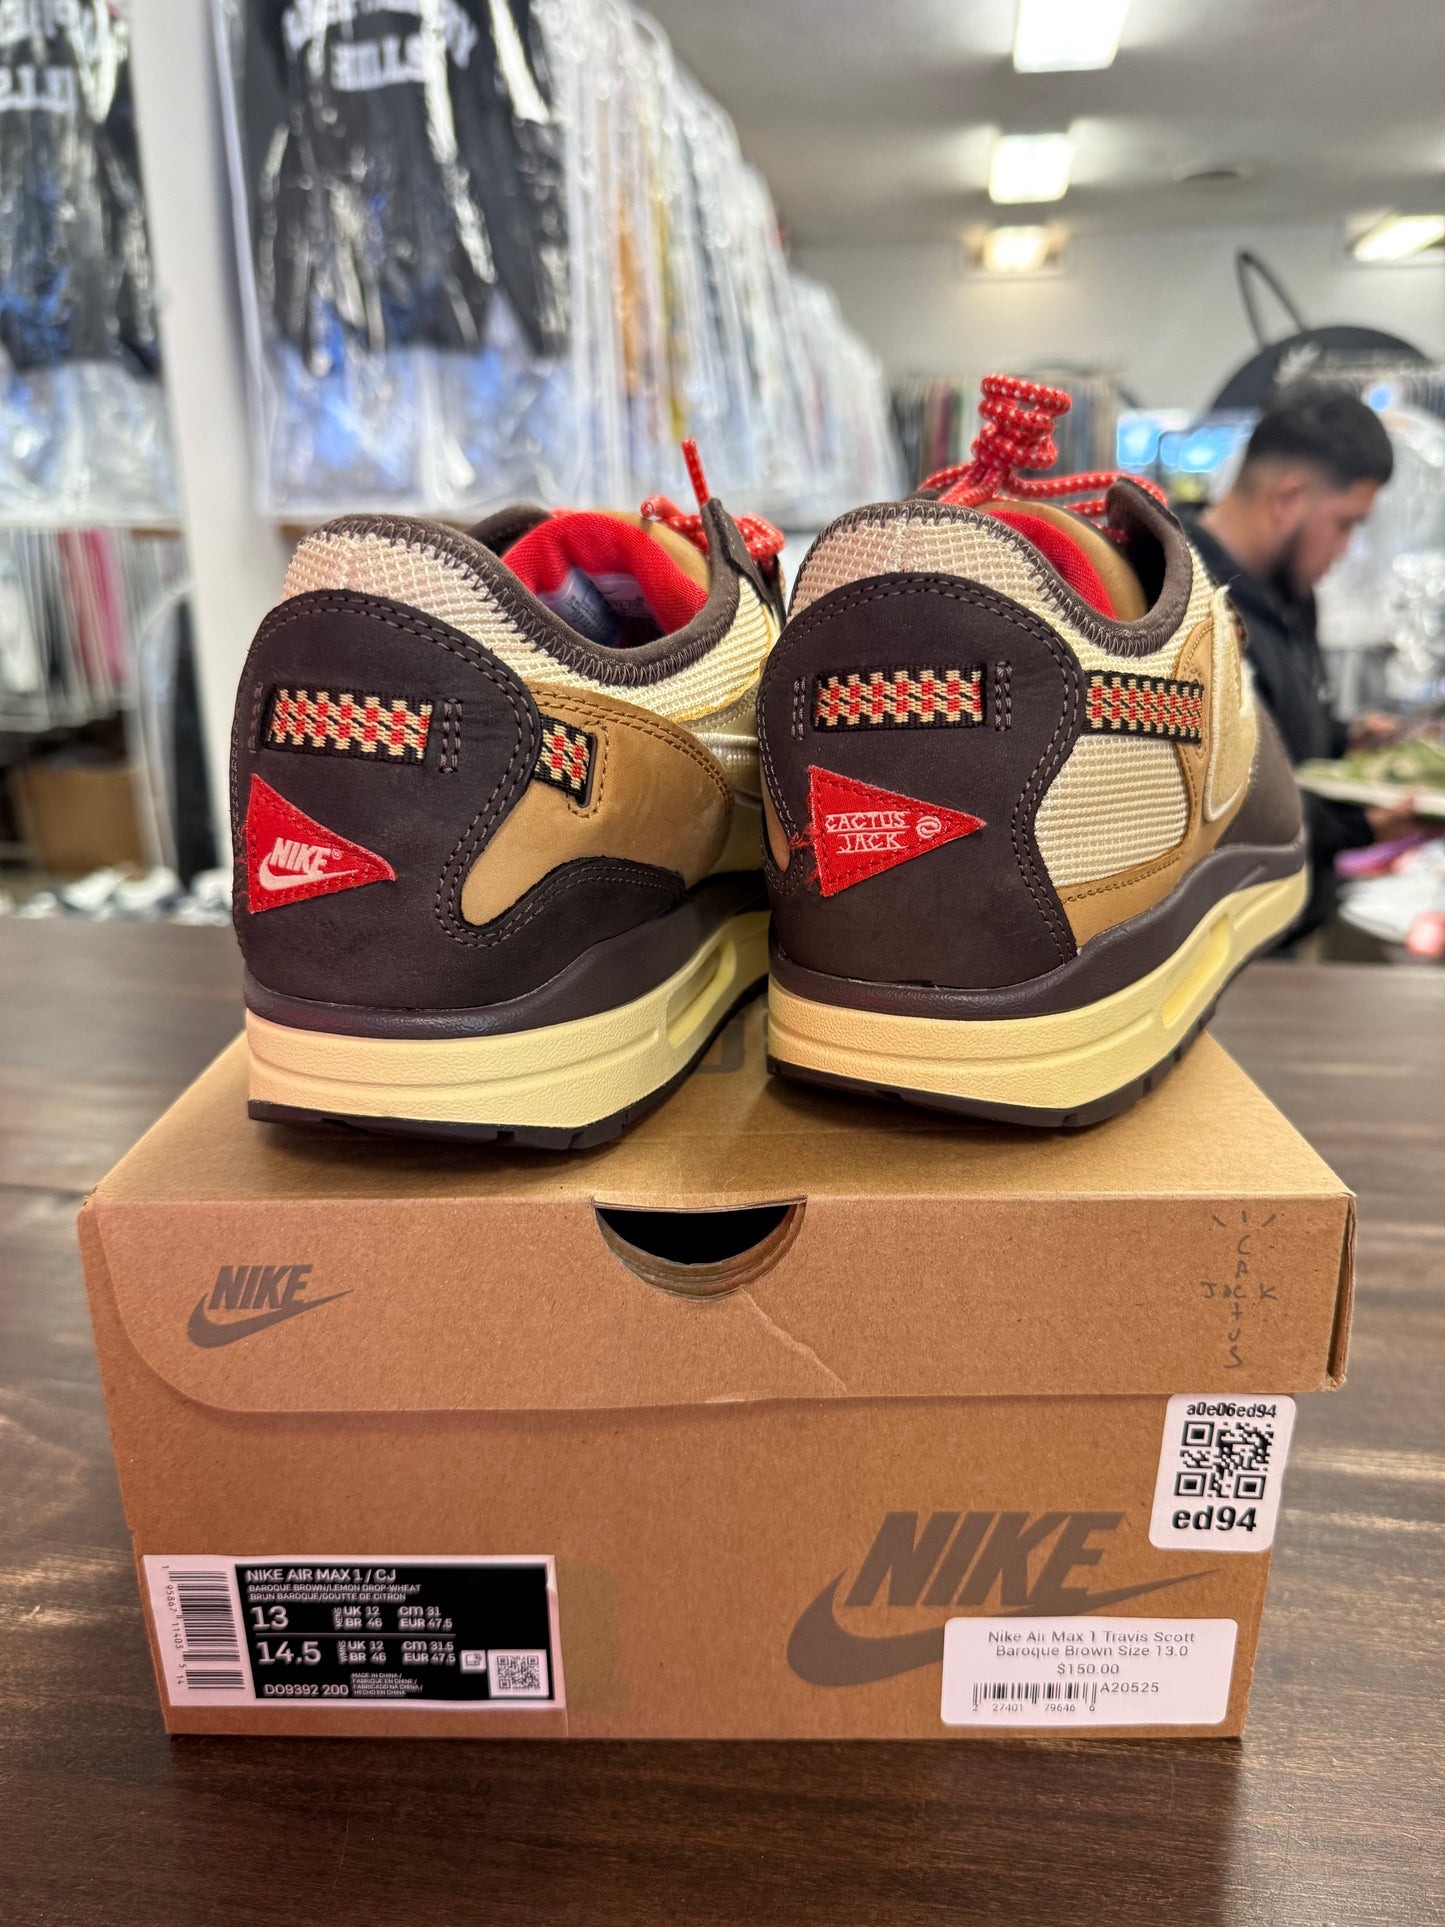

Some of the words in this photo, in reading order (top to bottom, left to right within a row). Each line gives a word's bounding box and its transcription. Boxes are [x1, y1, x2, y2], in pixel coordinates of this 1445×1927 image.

[825, 811, 910, 832] CACTUS
[836, 831, 909, 854] JACK
[208, 1264, 313, 1310] NIKE
[1186, 1402, 1277, 1418] a0e06ed94
[1172, 1506, 1257, 1533] ed94
[844, 1512, 1124, 1606] NIKE
[246, 1569, 284, 1582] NIKE
[286, 1569, 313, 1582] AIR
[316, 1569, 351, 1582] MAX
[352, 1569, 363, 1582] 1
[374, 1569, 397, 1582] CJ
[249, 1584, 291, 1593] BAROQUE
[294, 1584, 361, 1592] BROWN/LEMON
[362, 1584, 422, 1592] DROP-WHEAT
[250, 1593, 275, 1601] BRUN
[277, 1592, 357, 1601] BAROQUE/GOUTTE
[359, 1592, 371, 1600] DE
[373, 1592, 406, 1600] CITRON
[165, 1585, 178, 1612] 95867
[172, 1623, 184, 1649] 11403
[251, 1605, 289, 1630] 13
[344, 1606, 362, 1616] UK
[365, 1606, 381, 1616] 12
[426, 1606, 440, 1616] 31
[345, 1618, 362, 1629] BR
[366, 1618, 383, 1629] 46
[400, 1618, 426, 1629] EUR
[427, 1618, 453, 1629] 47.5
[988, 1631, 1022, 1643] Nike
[1052, 1631, 1084, 1643] Max
[1089, 1631, 1096, 1643] 1
[1102, 1631, 1148, 1643] Travis
[1153, 1631, 1195, 1643] Scott
[348, 1641, 366, 1650] UK
[369, 1641, 384, 1650] 12
[996, 1645, 1059, 1659] Baroque
[1064, 1645, 1112, 1656] Brown
[1118, 1645, 1149, 1656] Size
[1156, 1645, 1188, 1656] 13.0
[256, 1641, 321, 1665] 14.5
[350, 1653, 367, 1663] BR
[371, 1653, 387, 1663] 46
[404, 1653, 430, 1663] EUR
[430, 1653, 456, 1664] 47.5
[1057, 1663, 1119, 1676] $150.00
[321, 1684, 349, 1696] 200
[1100, 1682, 1159, 1693] A20525
[992, 1703, 1024, 1712] 27401
[1044, 1703, 1076, 1712] 79646
[1089, 1703, 1096, 1712] 6
